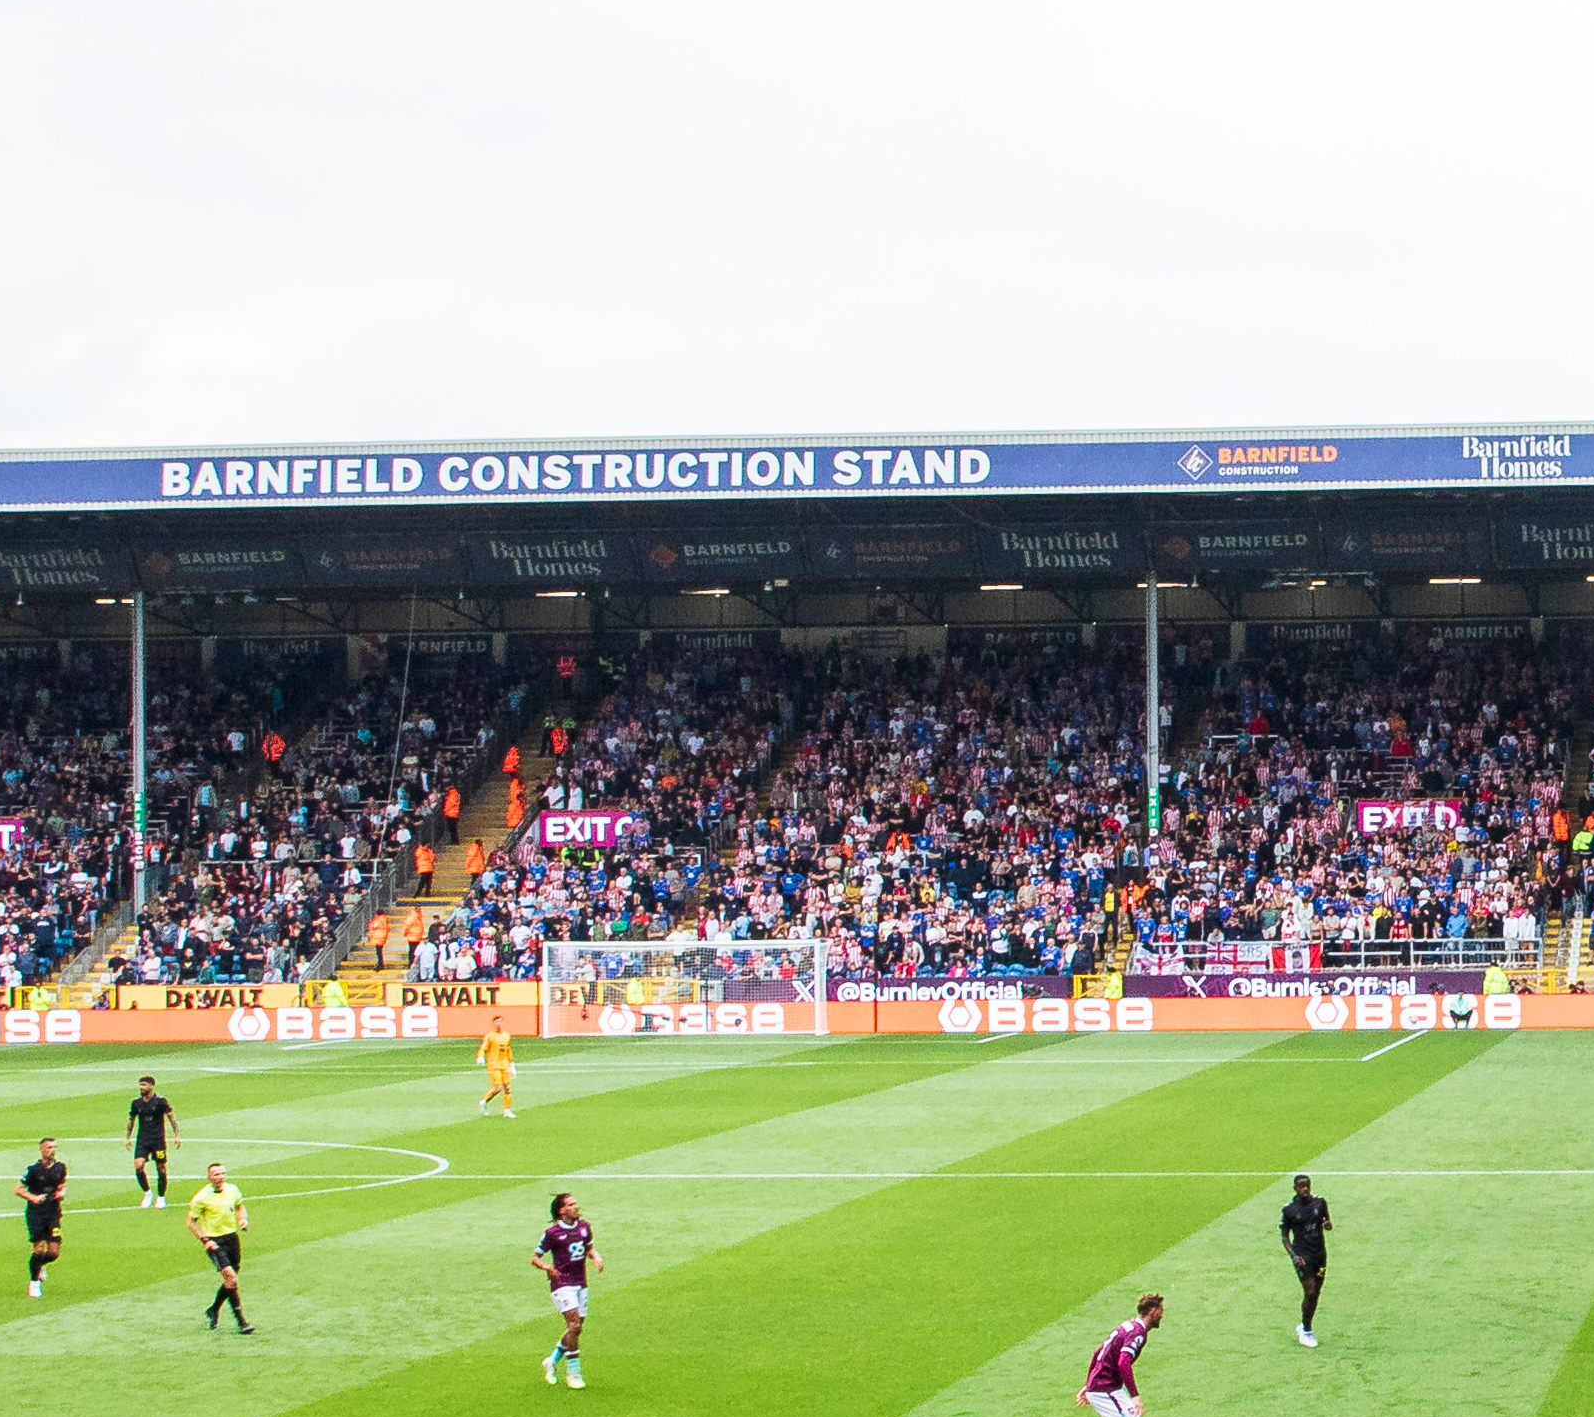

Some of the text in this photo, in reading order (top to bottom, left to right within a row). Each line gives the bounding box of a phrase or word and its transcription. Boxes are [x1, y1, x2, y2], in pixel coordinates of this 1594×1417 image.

[1217, 445, 1338, 465] BARNFIELD
[1461, 435, 1572, 459] Barnfield
[161, 449, 991, 497] BARNFIELD CONSTRUCTION STAND
[1218, 465, 1299, 477] CONSTRUCTION
[1481, 458, 1563, 479] Homes
[489, 539, 607, 560] Barnfield
[683, 542, 792, 558] BARNFIELD
[1001, 531, 1119, 553] Barnfield
[1199, 533, 1308, 549] BARNFIELD
[177, 550, 286, 566] BARNFIELD
[512, 558, 602, 577] Homes
[1023, 549, 1112, 569] Homes
[545, 816, 611, 842] EXIT
